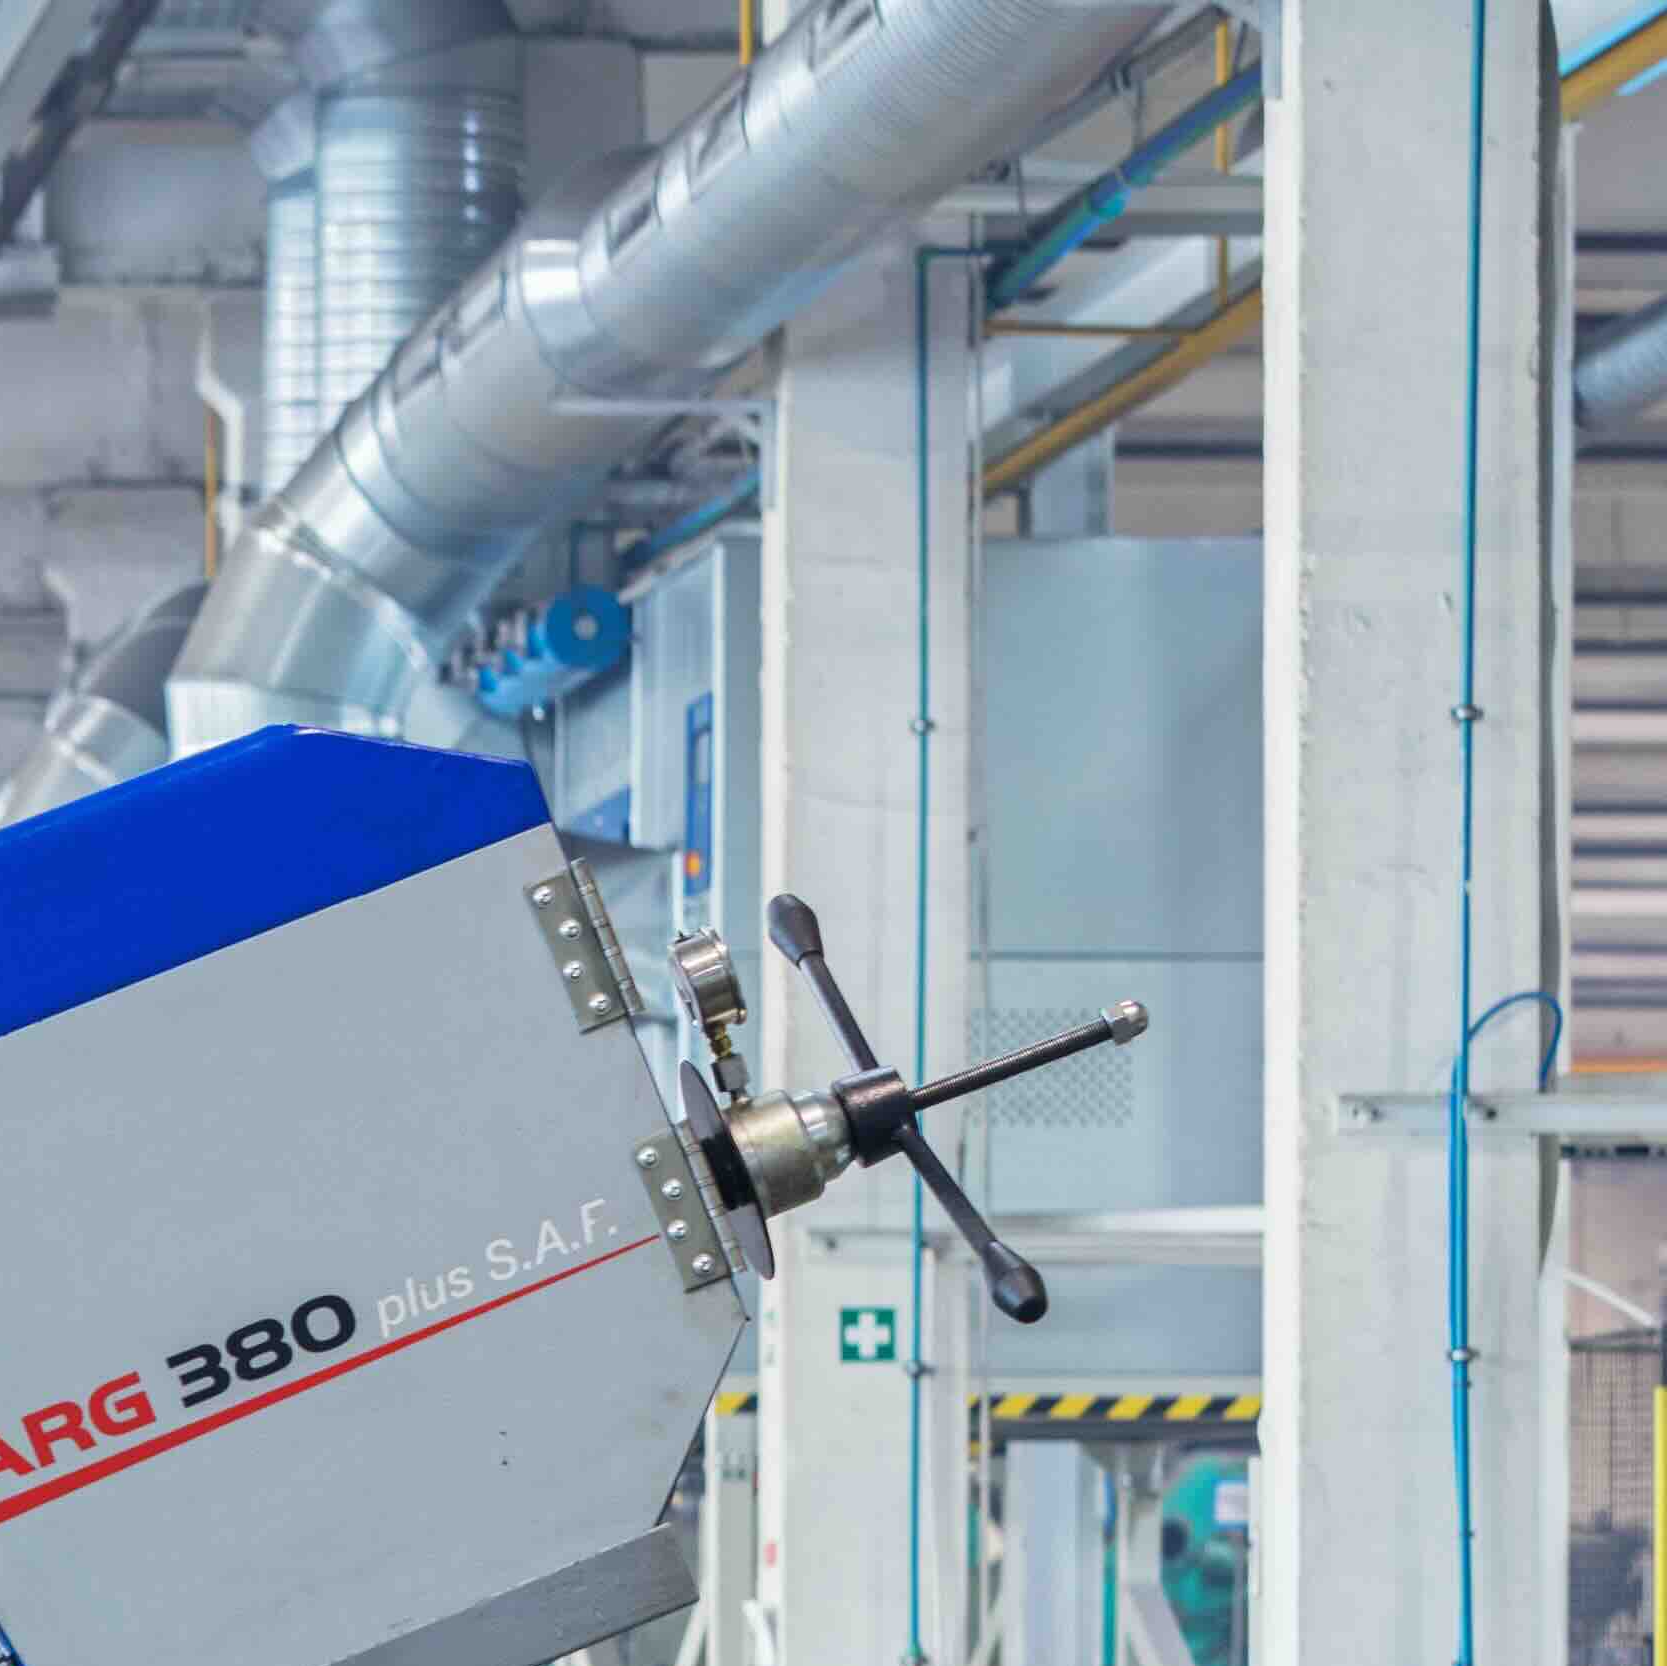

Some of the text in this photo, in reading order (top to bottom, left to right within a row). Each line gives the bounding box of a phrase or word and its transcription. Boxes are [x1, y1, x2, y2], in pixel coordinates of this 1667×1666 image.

[166, 1294, 356, 1408] 380
[378, 1265, 475, 1338] plus
[485, 1198, 618, 1281] S.A.F.
